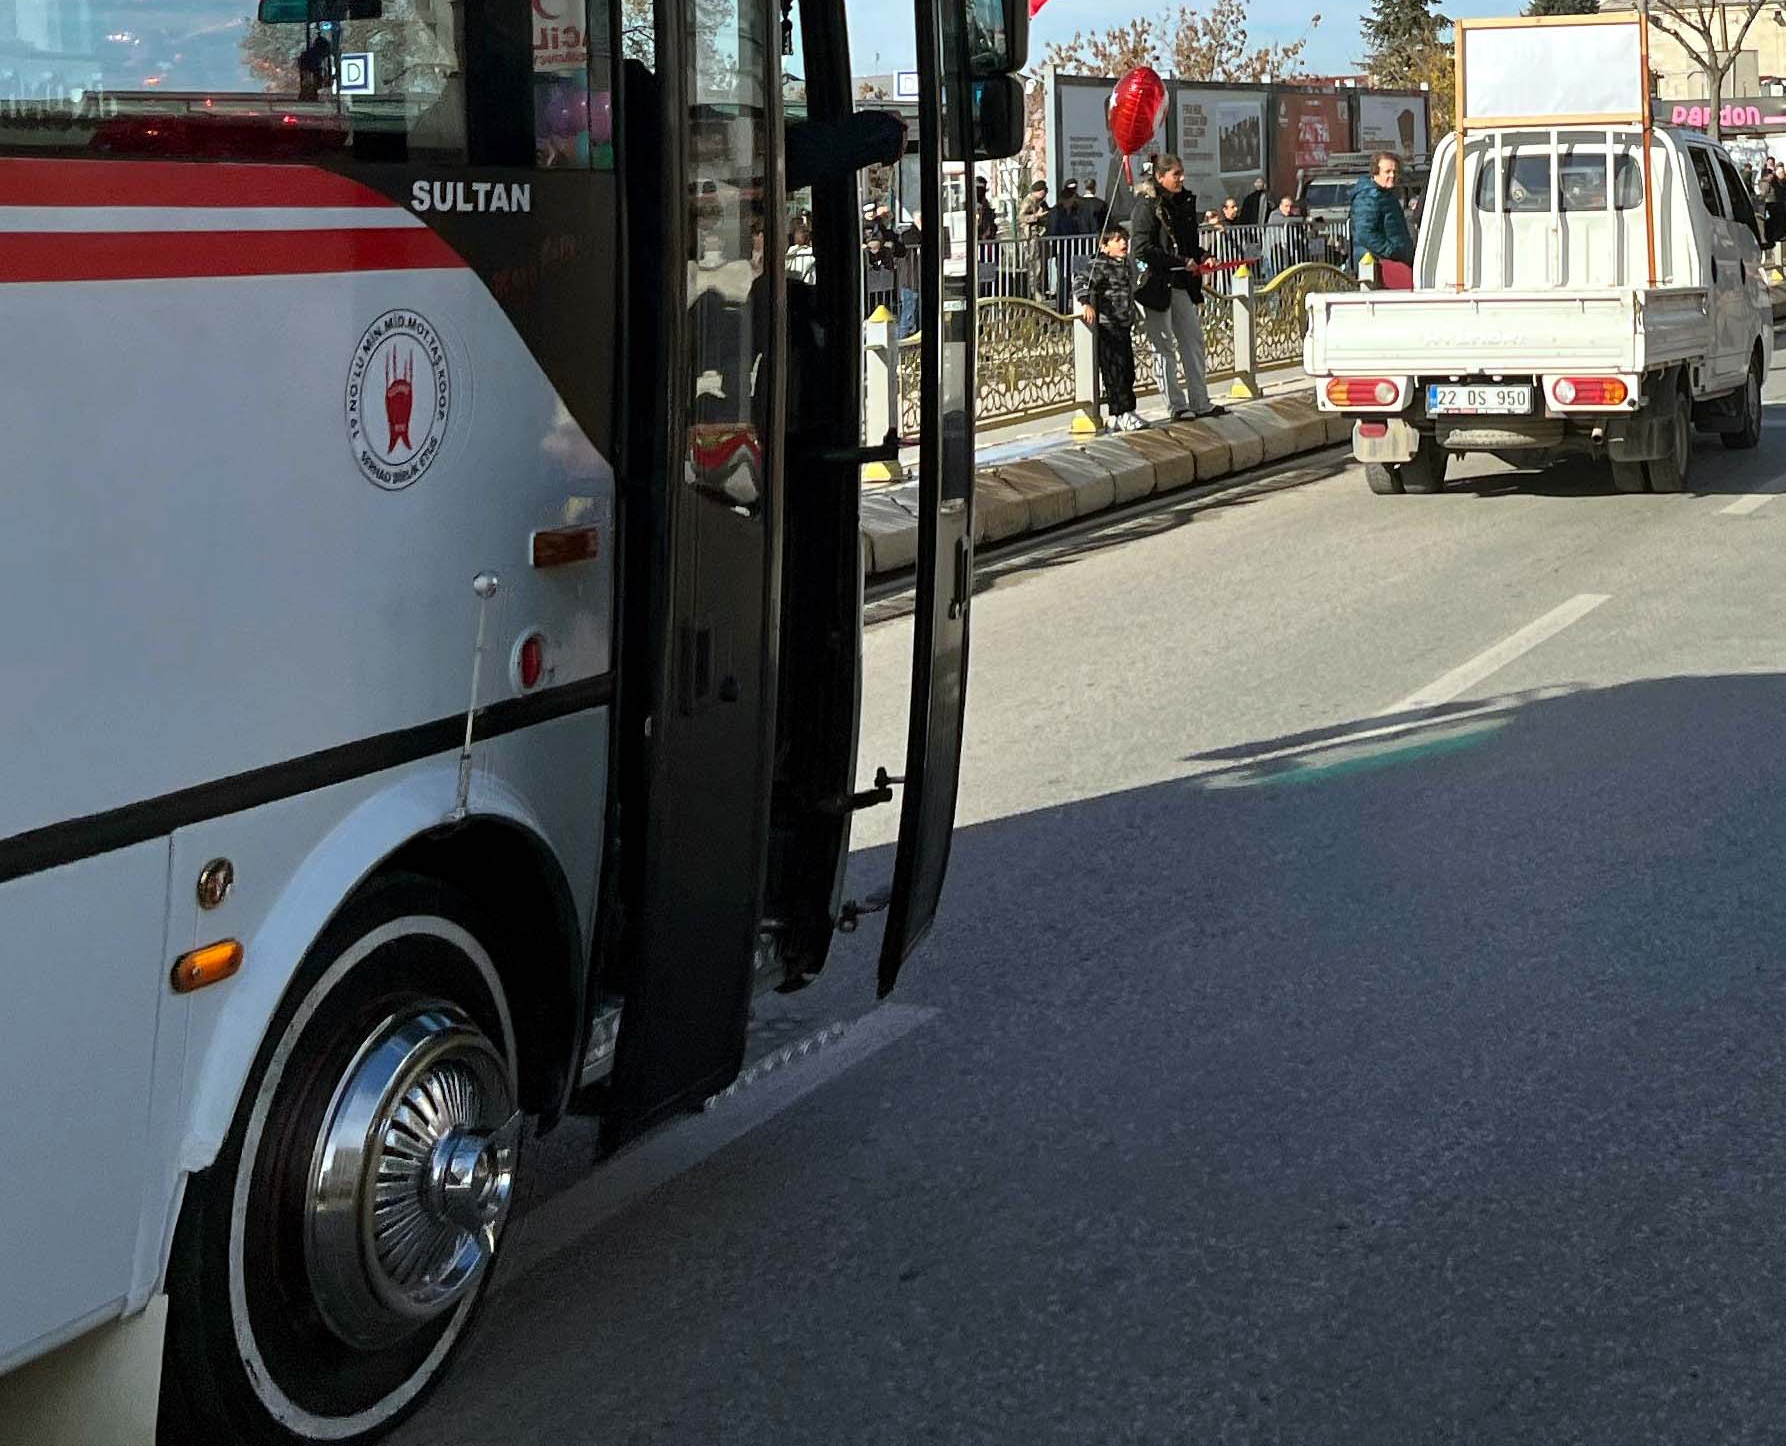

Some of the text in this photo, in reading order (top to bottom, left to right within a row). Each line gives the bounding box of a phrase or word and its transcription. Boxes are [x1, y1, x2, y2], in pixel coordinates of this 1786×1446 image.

[411, 180, 531, 212] SULTAN
[1438, 390, 1457, 406] 22
[1497, 390, 1526, 406] 950
